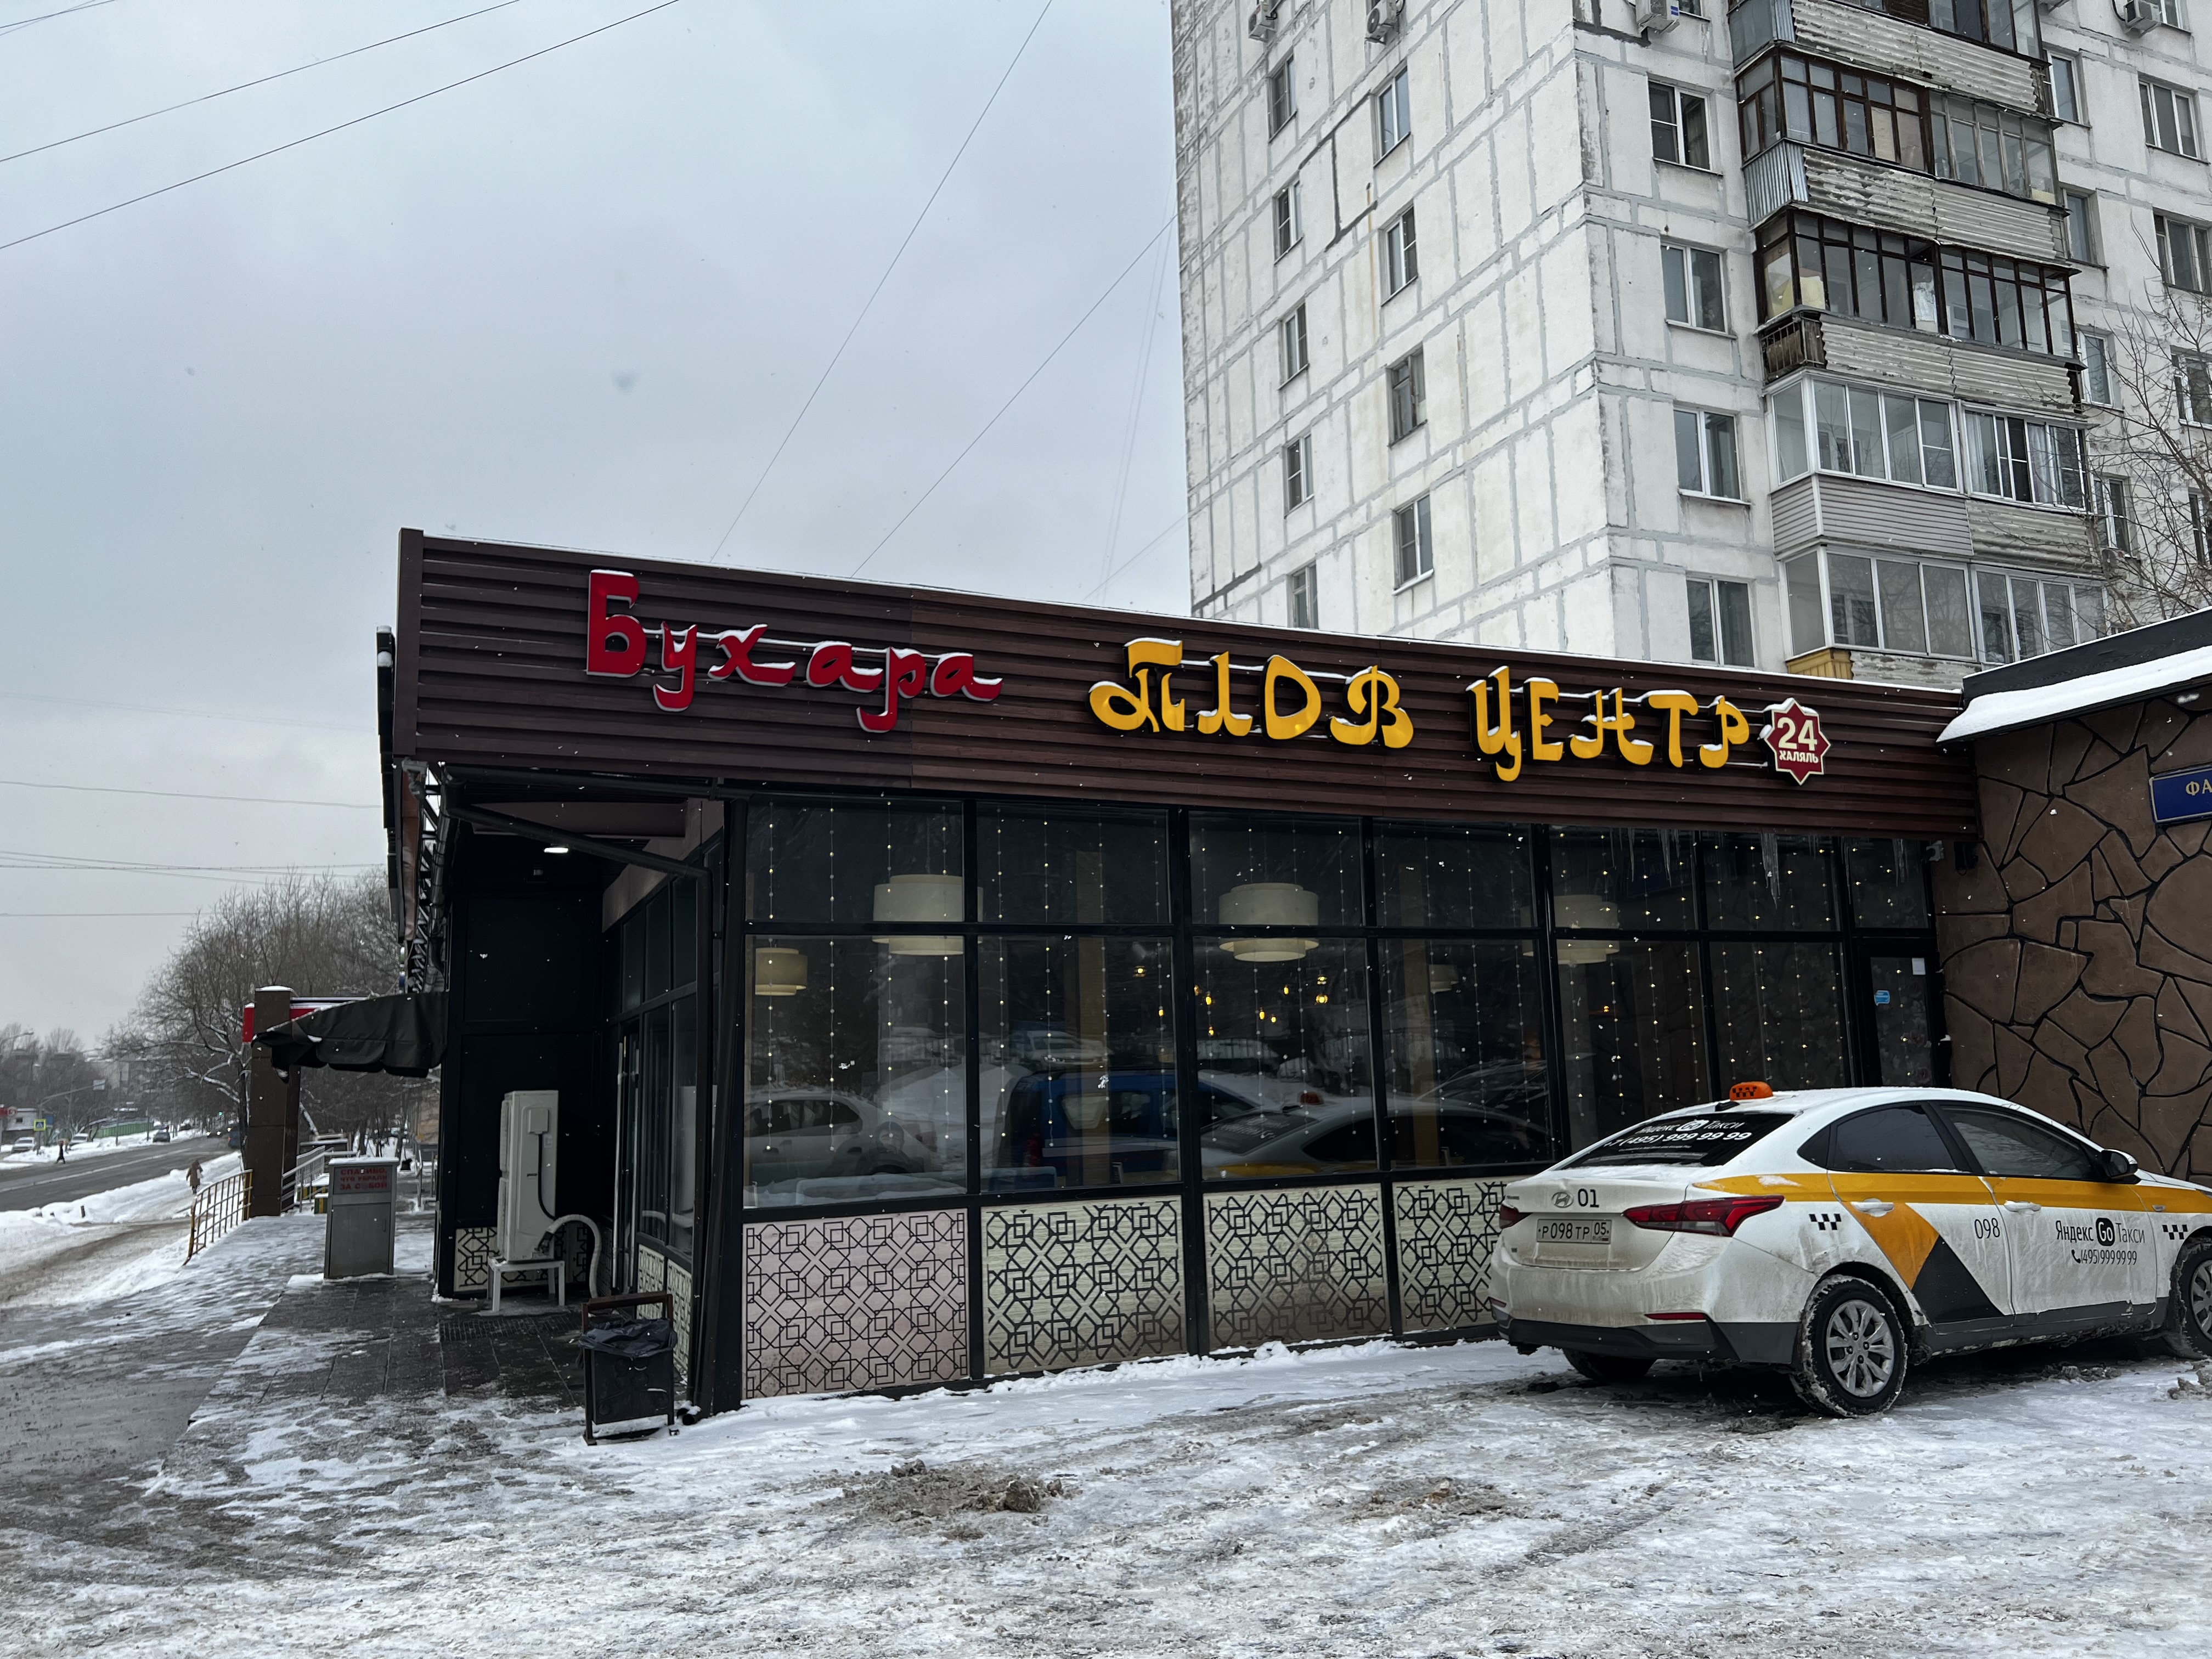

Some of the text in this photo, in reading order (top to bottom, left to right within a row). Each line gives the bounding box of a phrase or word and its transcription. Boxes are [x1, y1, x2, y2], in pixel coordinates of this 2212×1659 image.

[586, 569, 1003, 733] Бухара
[1088, 638, 1750, 782] ПЛОВ ЦЕНТР
[1778, 717, 1817, 751] 24
[1779, 750, 1819, 764] ХАЛЯЛЬ
[2186, 779, 2212, 796] ФА
[1619, 1135, 1664, 1146] (495)
[1662, 1133, 1699, 1142] 999
[1696, 1132, 1725, 1140] 99
[1723, 1132, 1752, 1140] 99
[1578, 1188, 1599, 1207] 01
[1974, 1217, 2001, 1239] 098
[2055, 1220, 2145, 1244] Яндекс Go Такси
